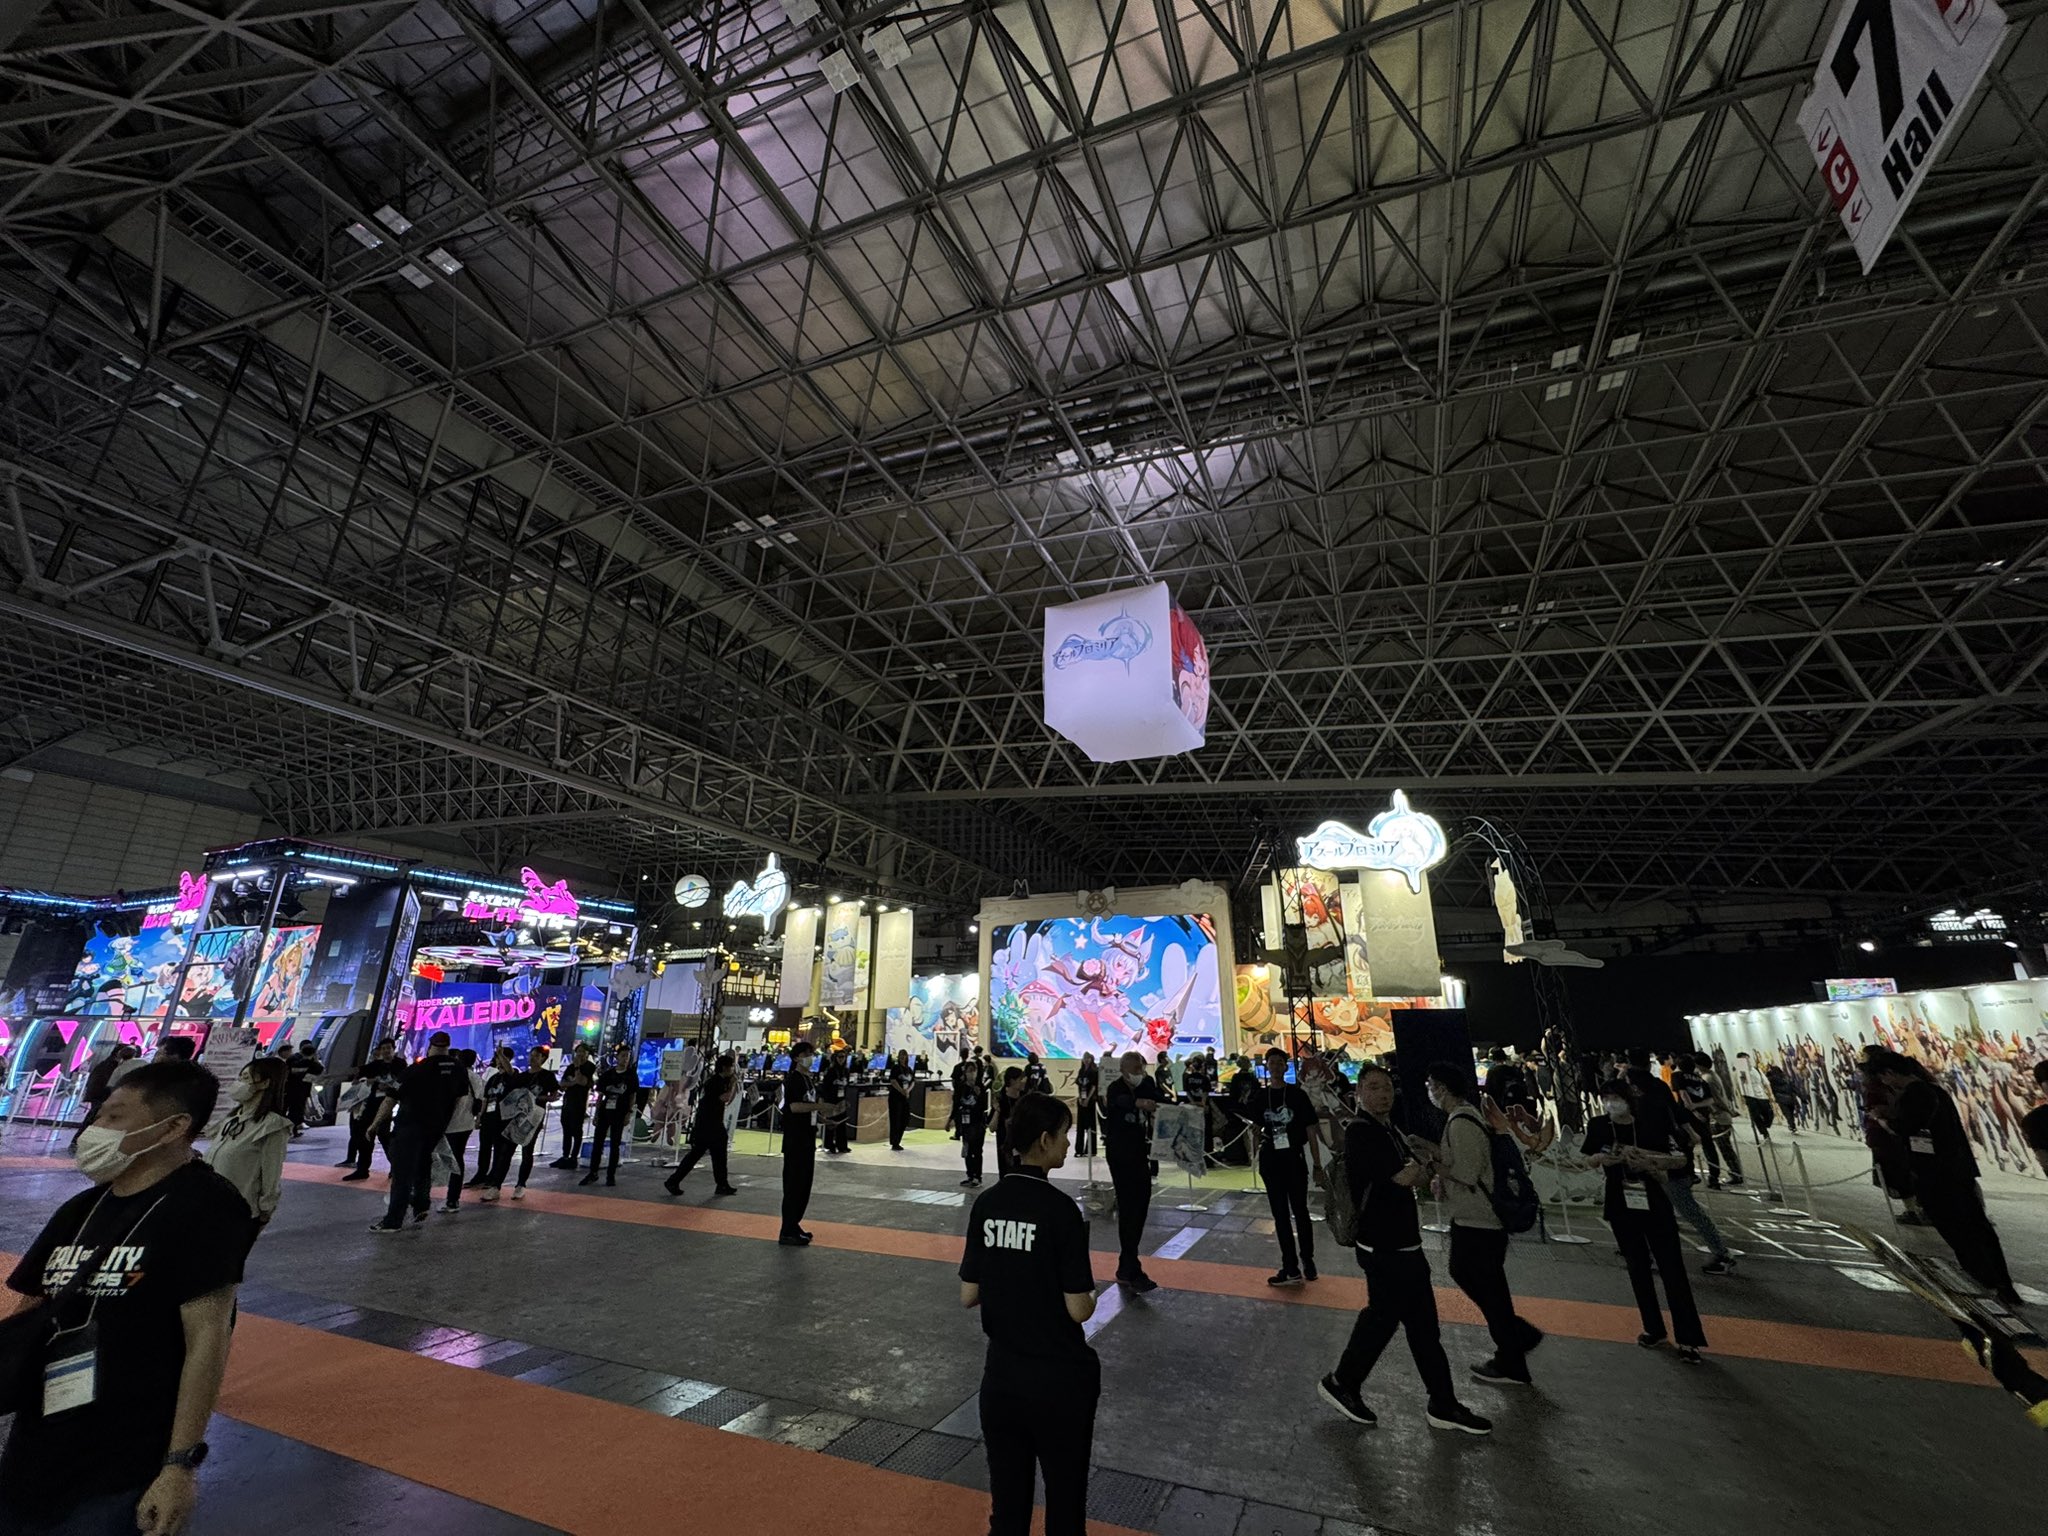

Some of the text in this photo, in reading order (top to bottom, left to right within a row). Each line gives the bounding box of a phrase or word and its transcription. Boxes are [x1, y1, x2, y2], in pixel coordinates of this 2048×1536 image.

[1881, 69, 1954, 201] Hall
[414, 996, 536, 1031] KALEIDO
[983, 1218, 1037, 1252] STAFF
